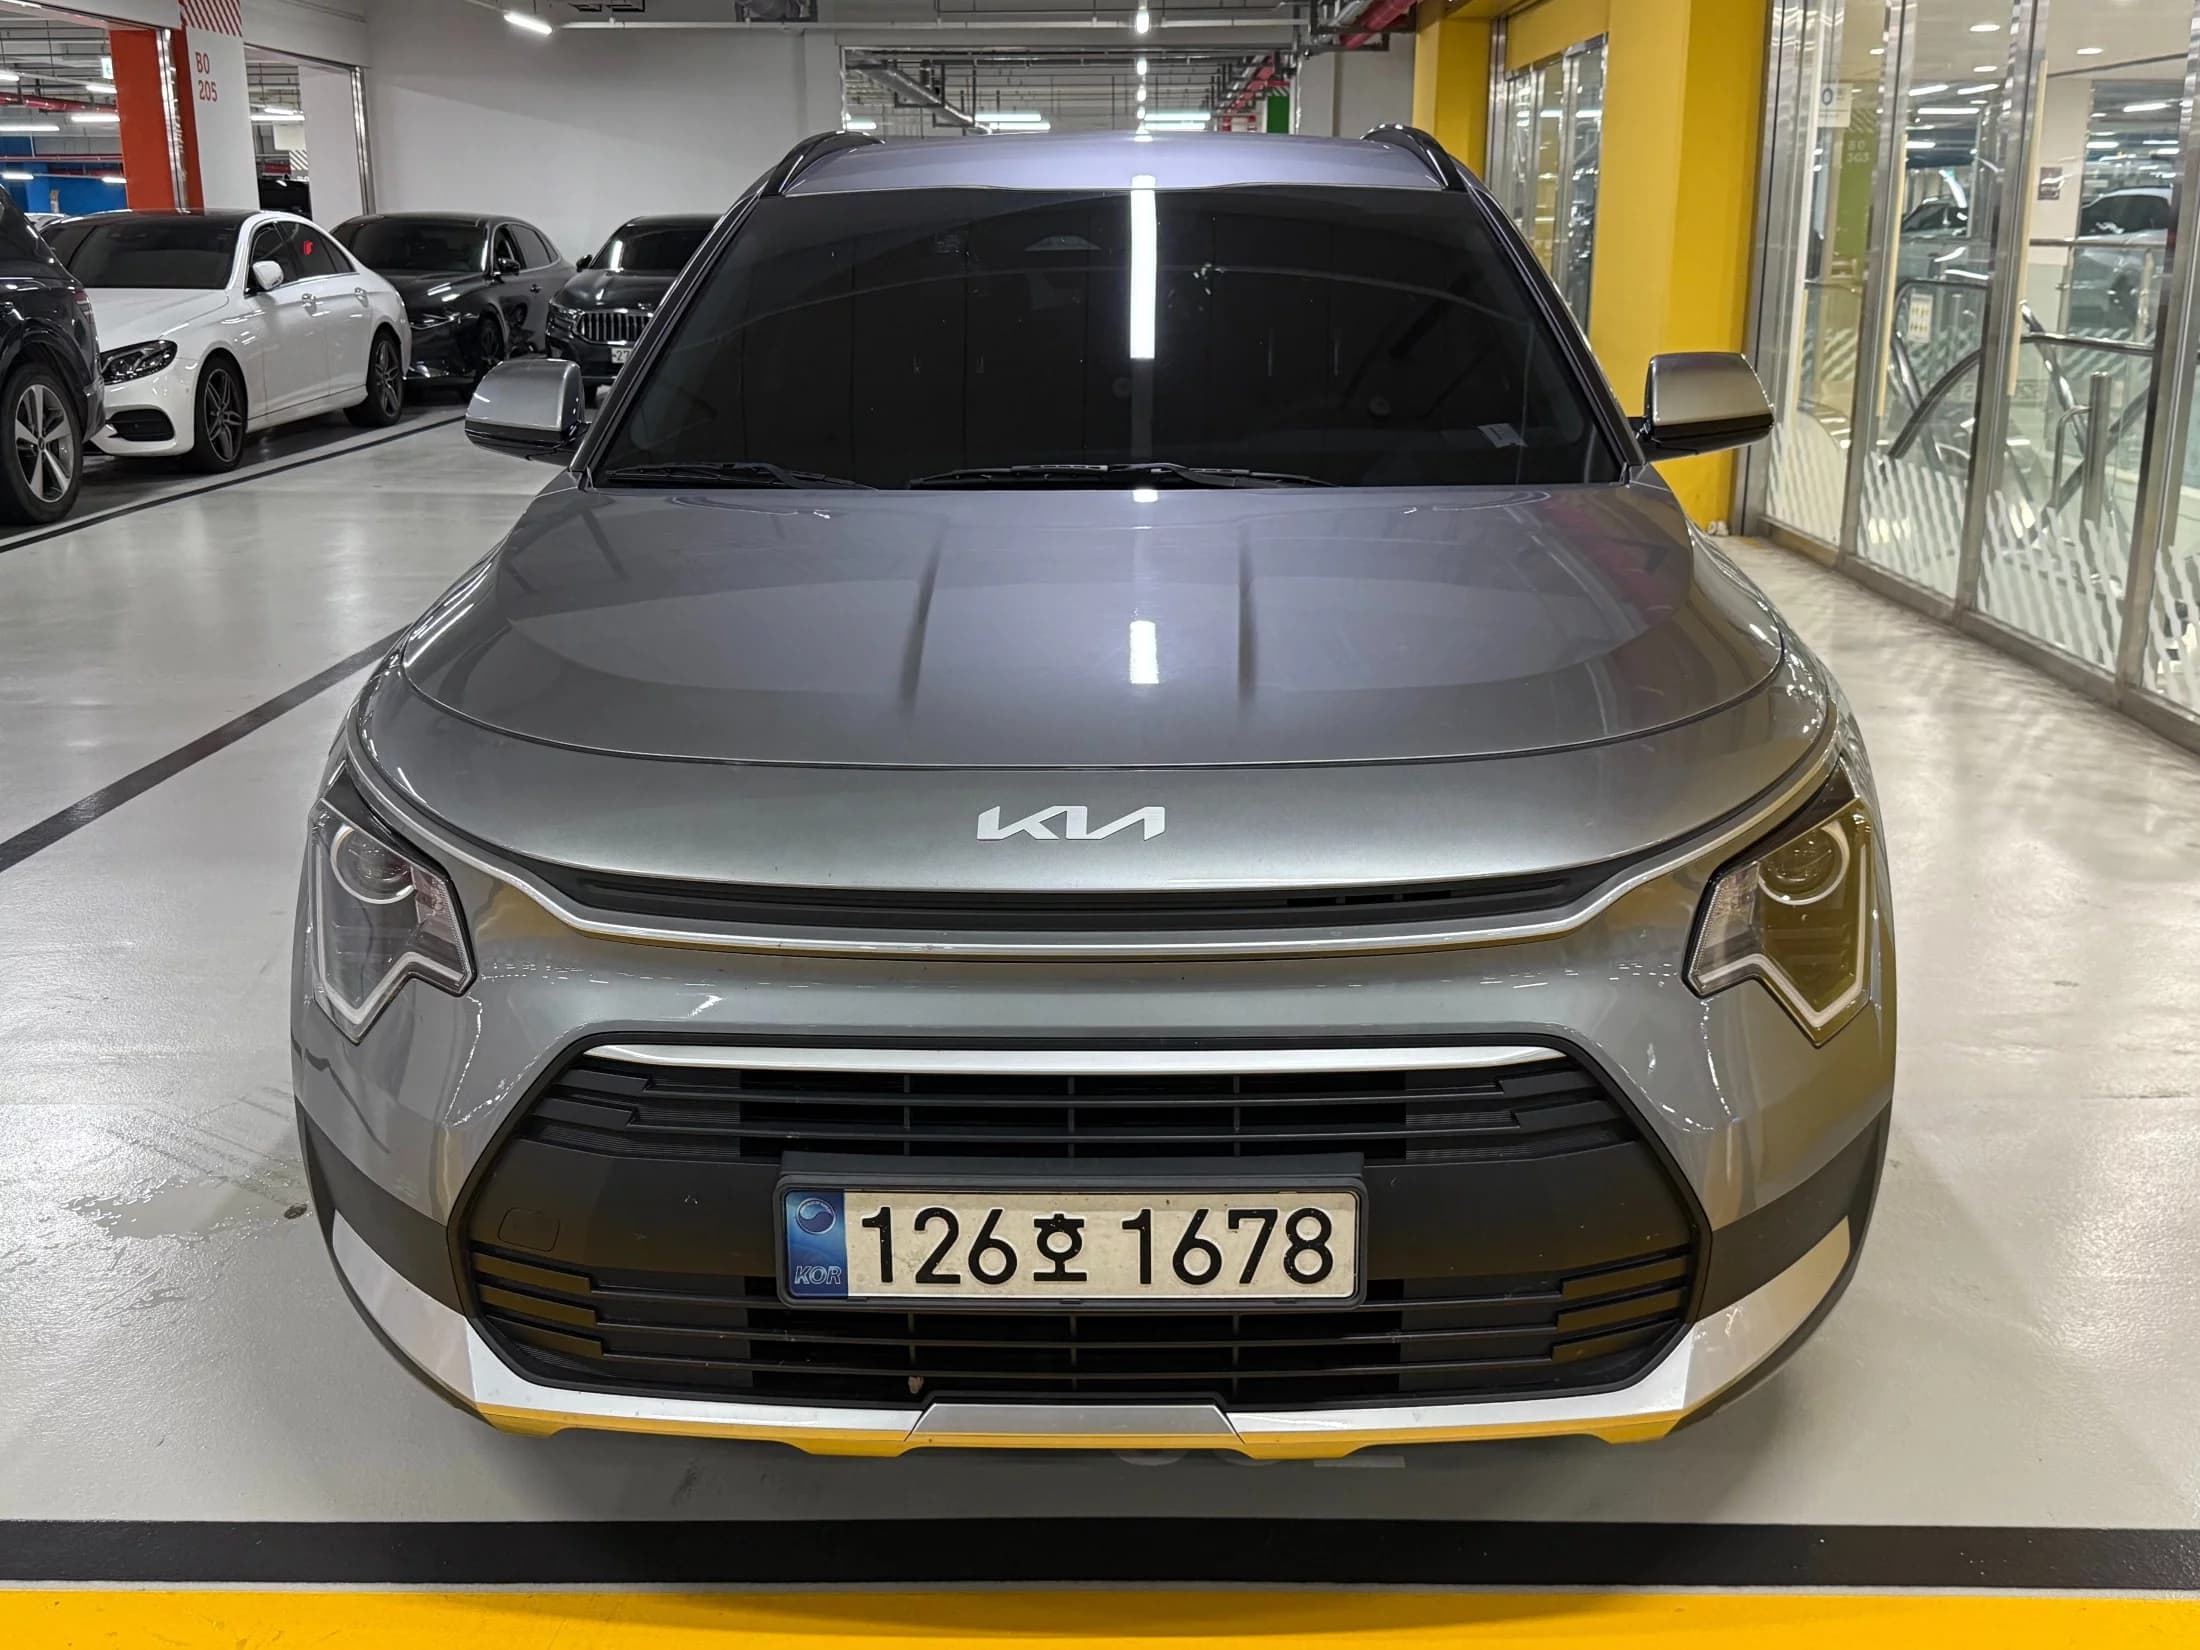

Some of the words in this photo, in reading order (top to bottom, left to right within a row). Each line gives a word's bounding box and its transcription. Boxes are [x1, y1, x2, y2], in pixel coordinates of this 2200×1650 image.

[198, 80, 218, 102] 205
[976, 805, 1166, 842] KIA
[861, 1206, 1088, 1285] 126호
[1121, 1207, 1334, 1286] 1678
[794, 1265, 842, 1285] KOR
